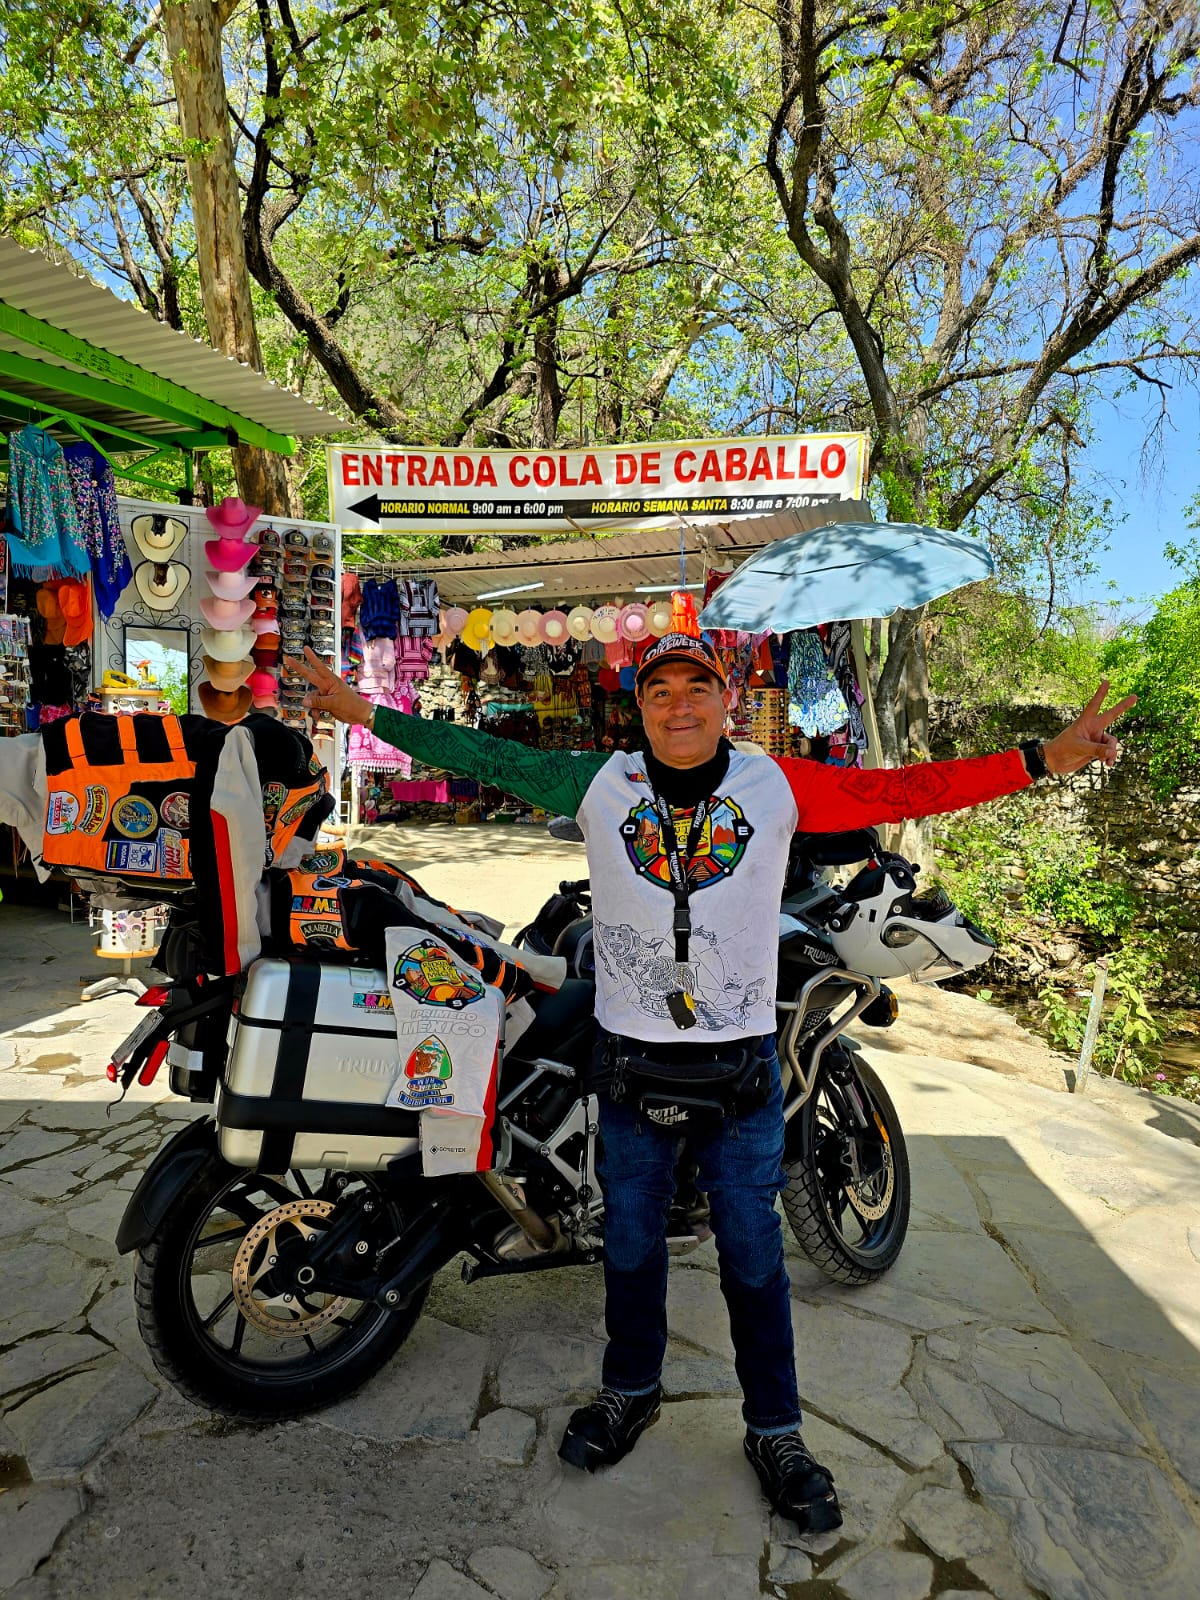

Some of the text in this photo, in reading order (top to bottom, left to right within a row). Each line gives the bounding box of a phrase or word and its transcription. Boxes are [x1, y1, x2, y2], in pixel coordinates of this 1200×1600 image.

[341, 443, 847, 488] ENTRADA COLA DE CABALLO
[380, 502, 564, 516] HORARIO NORMAL 9:00 am a 6:00 pm
[591, 501, 641, 514] HORARIO
[643, 499, 689, 513] SEMANA
[691, 498, 728, 511] SANTA
[730, 497, 754, 510] 8:30
[755, 500, 773, 510] am
[774, 500, 782, 509] a
[785, 496, 810, 508] 7:00
[738, 826, 749, 836] E
[670, 850, 683, 886] TRIUMPH
[303, 923, 338, 937] ARABELLA
[803, 944, 840, 966] TRIUMPH
[401, 1019, 487, 1038] MEXICO
[336, 1055, 400, 1077] TRIUM
